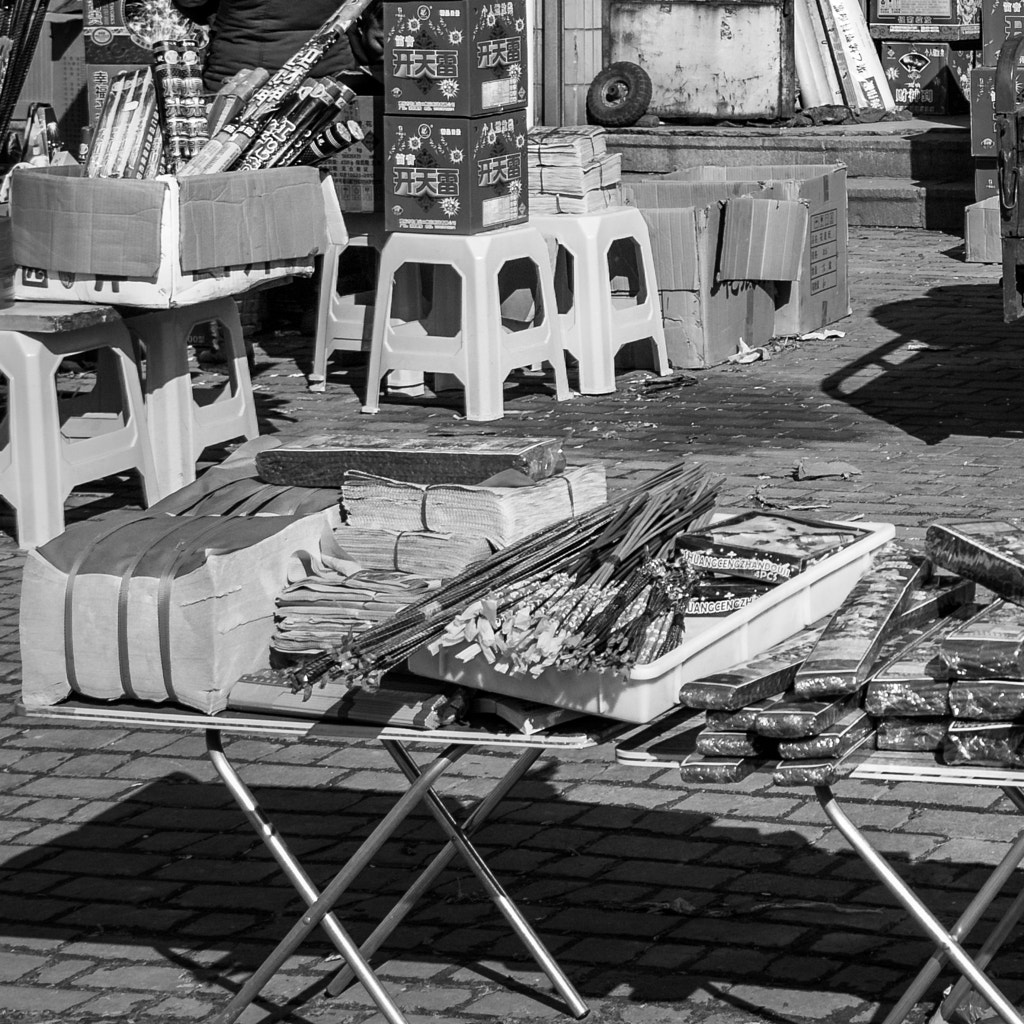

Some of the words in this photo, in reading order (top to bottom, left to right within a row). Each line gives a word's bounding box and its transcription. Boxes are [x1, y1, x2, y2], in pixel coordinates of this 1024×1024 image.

[392, 48, 459, 78] 开天雷
[476, 37, 522, 69] 开天雷
[392, 166, 460, 197] 开天雷
[477, 152, 522, 187] 开天雷
